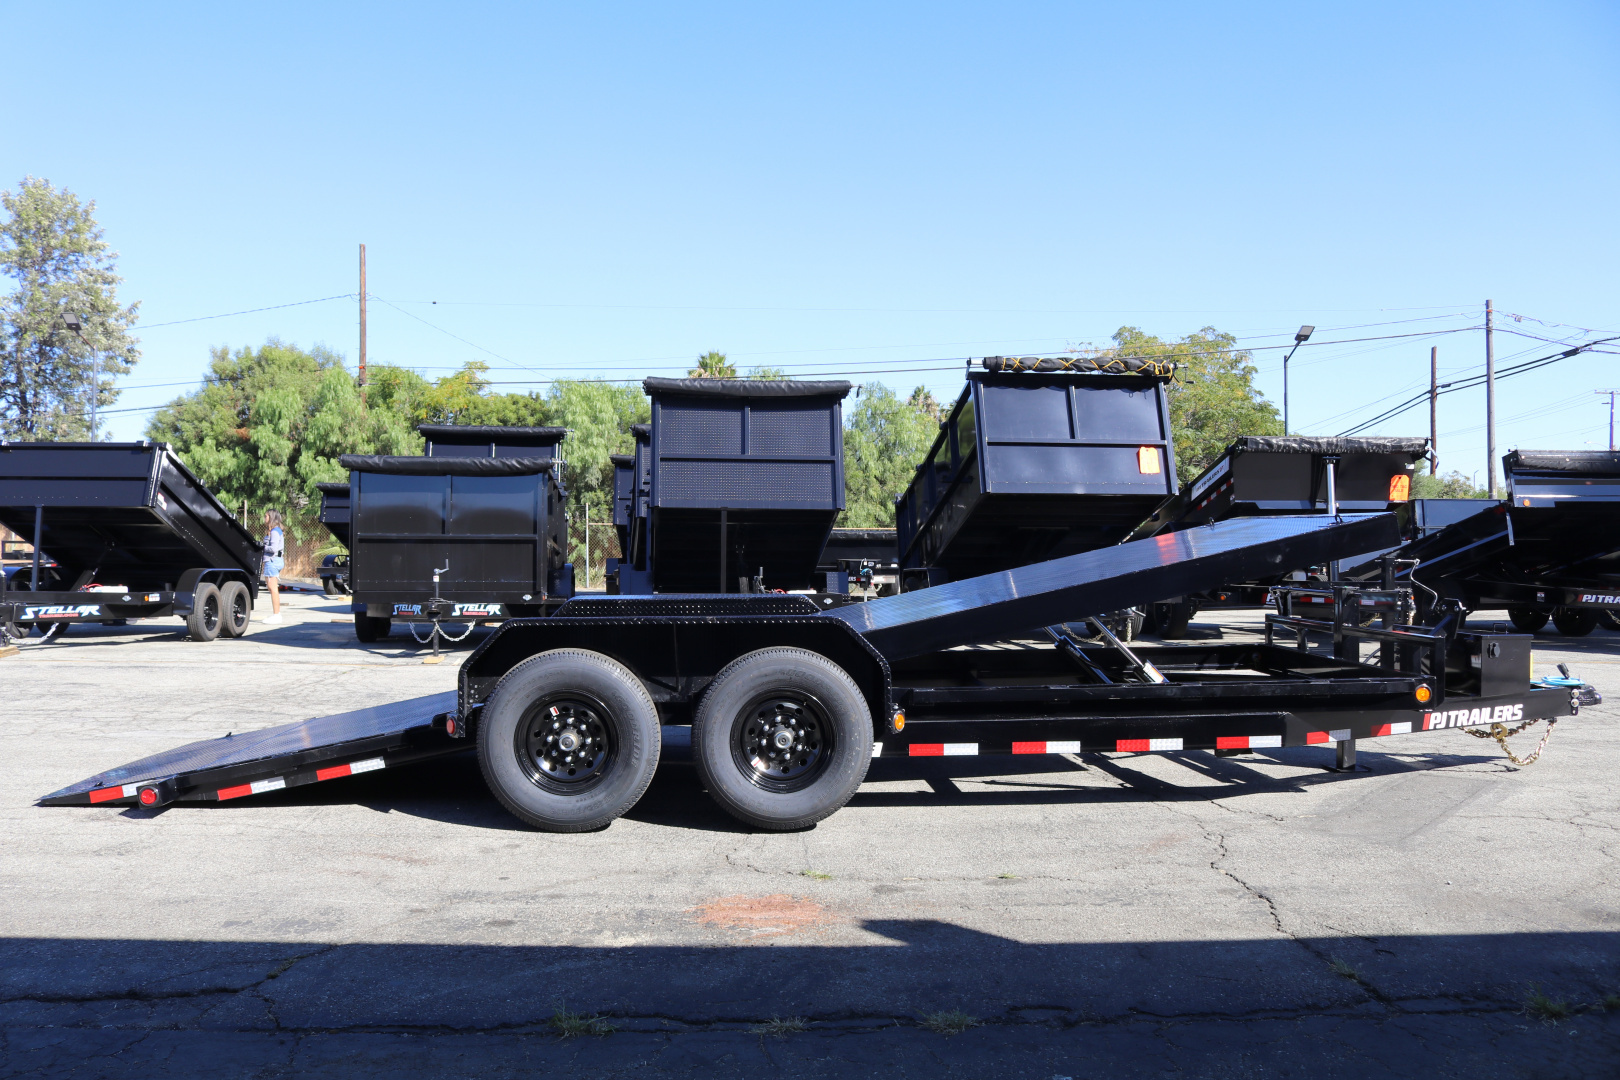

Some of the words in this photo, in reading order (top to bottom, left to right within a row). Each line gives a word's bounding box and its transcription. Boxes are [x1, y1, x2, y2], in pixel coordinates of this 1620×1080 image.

[20, 605, 101, 619] STELLAR
[393, 604, 422, 615] STELLAR
[451, 604, 502, 616] STELLAR
